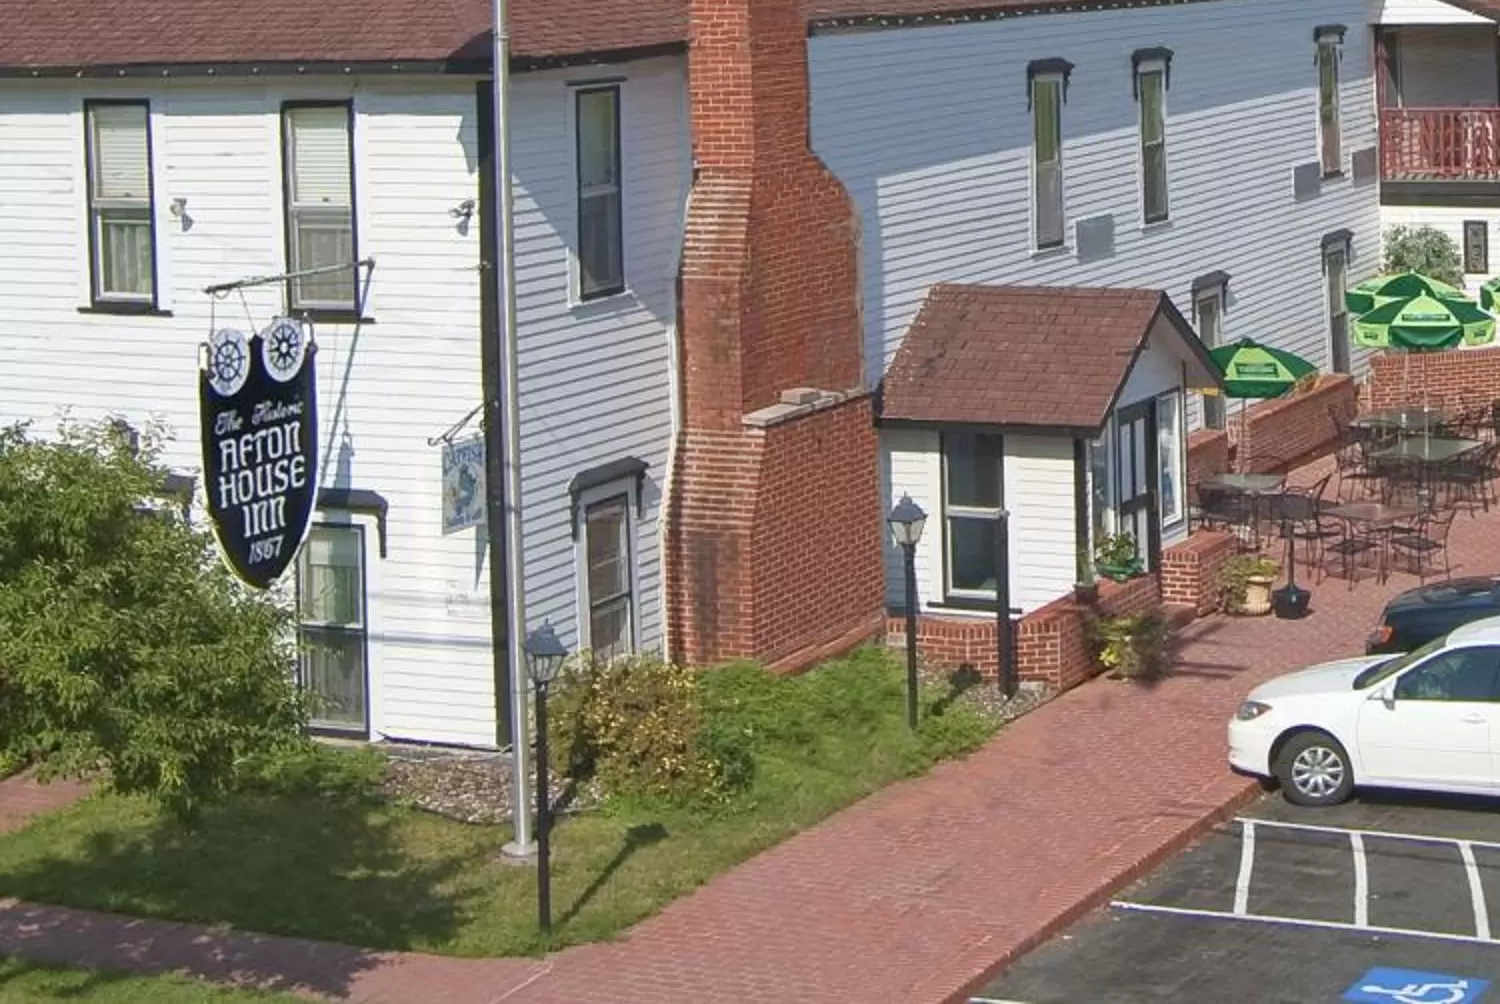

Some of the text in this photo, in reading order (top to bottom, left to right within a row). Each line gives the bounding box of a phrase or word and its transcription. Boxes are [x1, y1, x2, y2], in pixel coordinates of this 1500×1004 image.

[215, 409, 244, 435] The
[219, 420, 301, 473] AFTON
[218, 454, 305, 509] HOUSE
[242, 495, 286, 539] INN
[248, 535, 284, 565] 1867
